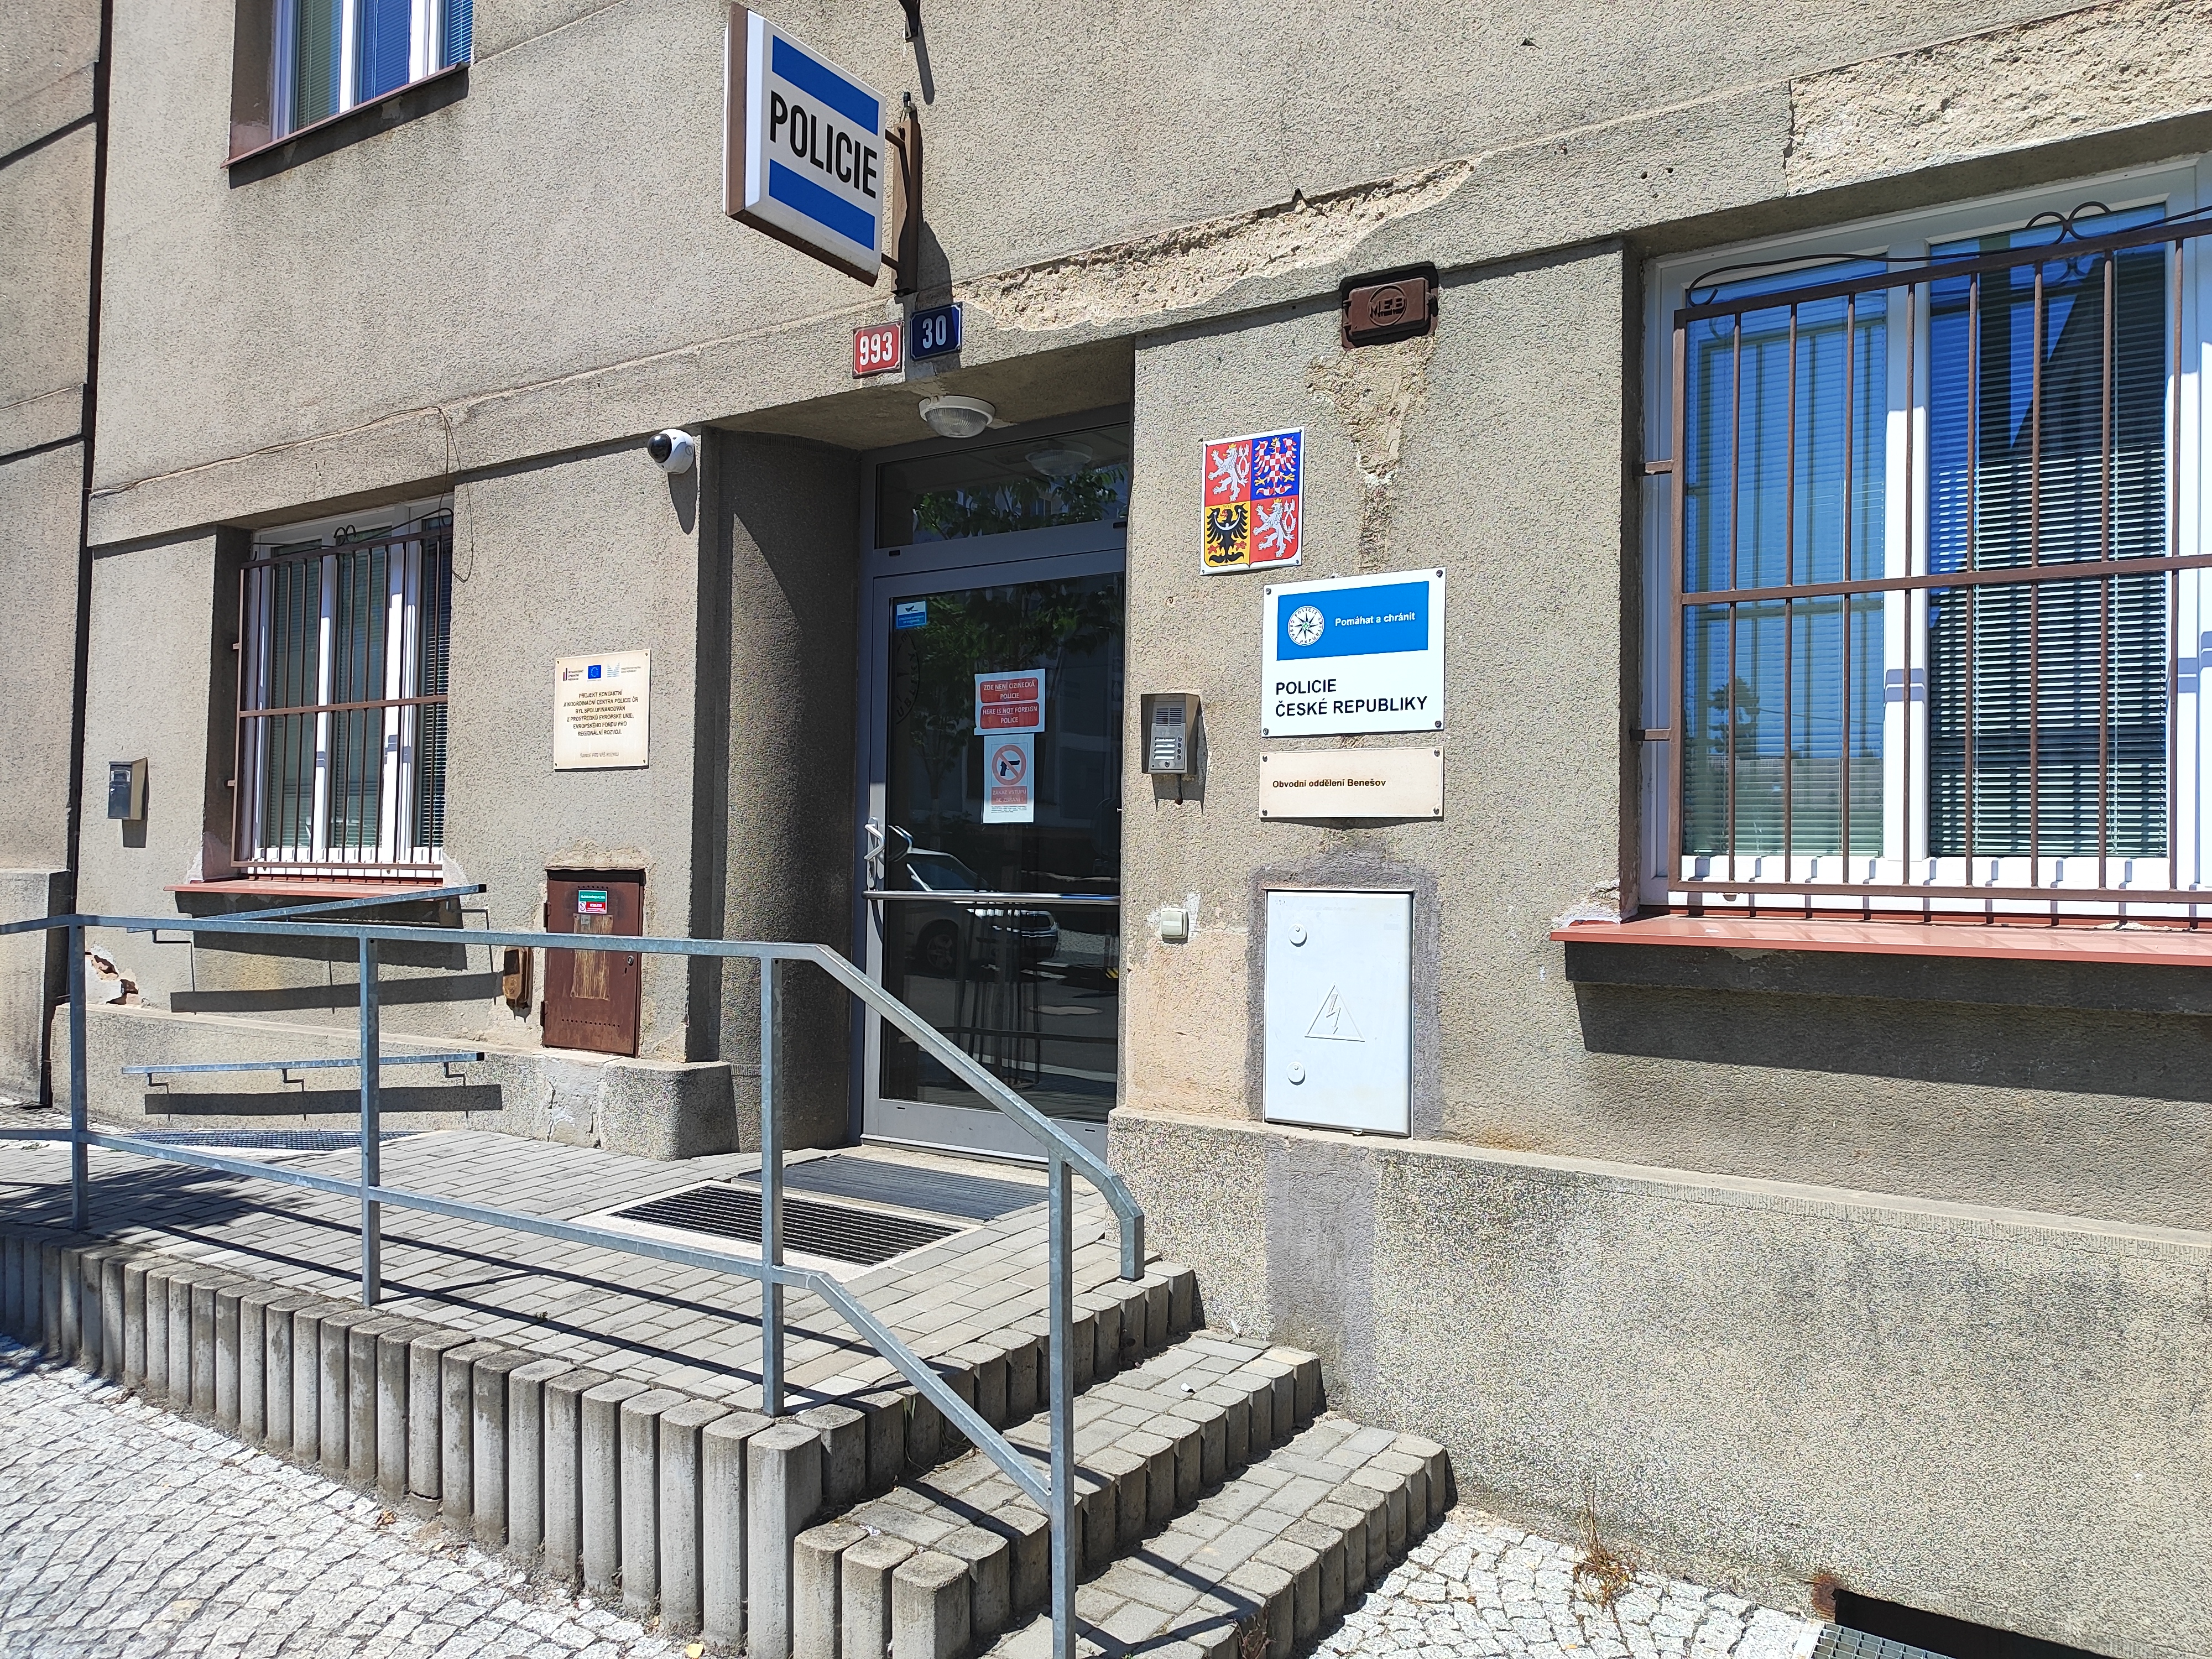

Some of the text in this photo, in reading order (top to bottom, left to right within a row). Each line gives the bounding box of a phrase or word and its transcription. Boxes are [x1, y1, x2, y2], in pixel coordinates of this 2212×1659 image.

[770, 90, 877, 199] POLICIE
[922, 315, 946, 348] 30
[860, 332, 893, 366] 993
[1335, 615, 1374, 627] Pomáhat
[1384, 612, 1416, 622] chránit
[995, 682, 1008, 690] NENÍ
[1009, 680, 1035, 689] CIZINECKÁ
[1276, 679, 1337, 695] POLICIE
[567, 698, 596, 707] KOORDINAČNÍ
[1275, 696, 1428, 717] ČESKÉ REPUBLIKY
[1272, 778, 1386, 787] Obvodní oddělení Benešov
